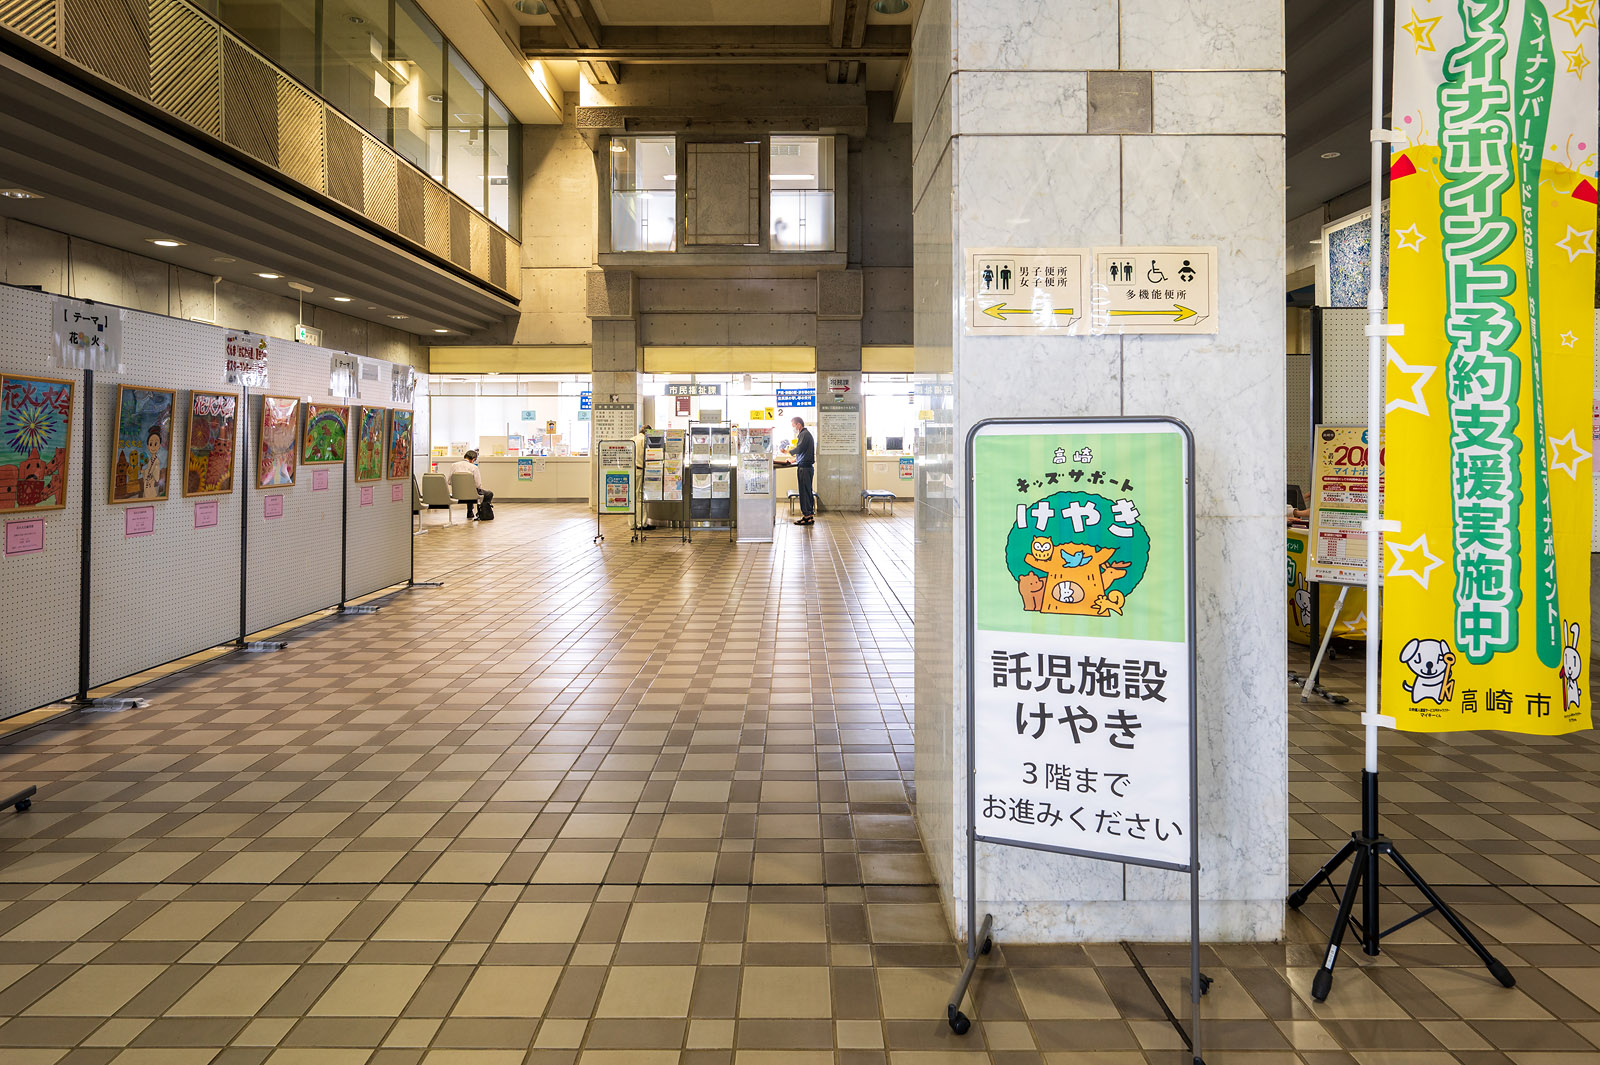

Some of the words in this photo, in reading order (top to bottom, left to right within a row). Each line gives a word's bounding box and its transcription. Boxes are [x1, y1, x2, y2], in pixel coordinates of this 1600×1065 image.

[1019, 266, 1068, 277] 男子便所
[1019, 277, 1068, 288] 女子便所
[1126, 289, 1187, 301] 多機能便所
[1442, 0, 1516, 659] マイナポイント予約支援実施中
[2, 379, 70, 424] 花火大会
[668, 385, 717, 395] 市民福祉課
[778, 408, 784, 416] 2
[1051, 446, 1094, 465] 高崎
[1015, 469, 1135, 494] キッズサポート
[1016, 498, 1141, 539] けやき
[992, 649, 1169, 704] 託児施設
[1461, 688, 1552, 718] 高崎市
[1015, 702, 1143, 751] けやき
[1021, 761, 1131, 799] 3階まで
[982, 793, 1184, 843] お進みください
